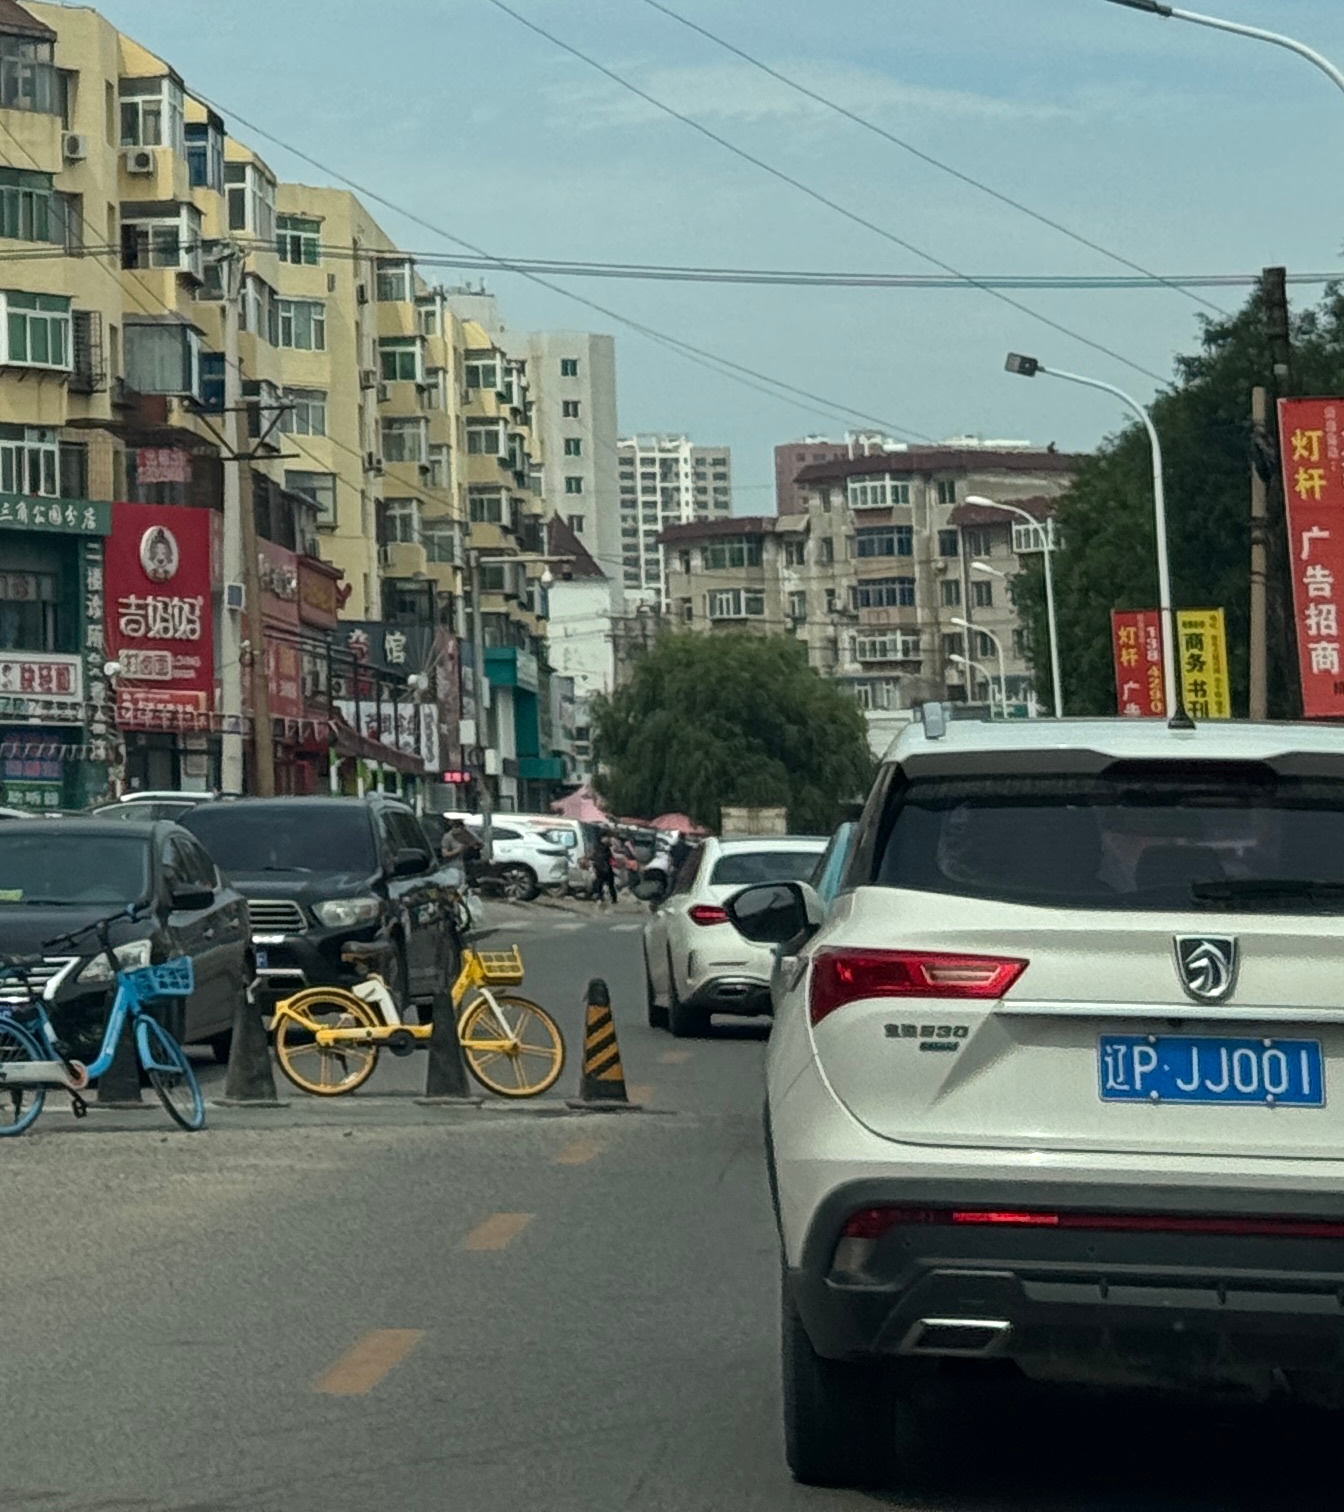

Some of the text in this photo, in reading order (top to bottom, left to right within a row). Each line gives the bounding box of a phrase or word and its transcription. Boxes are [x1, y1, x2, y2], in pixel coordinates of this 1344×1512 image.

[1291, 429, 1340, 675] 灯杆 广告招商
[1118, 625, 1139, 667] 灯杆
[1104, 1044, 1310, 1095] 辽P·JJ001
